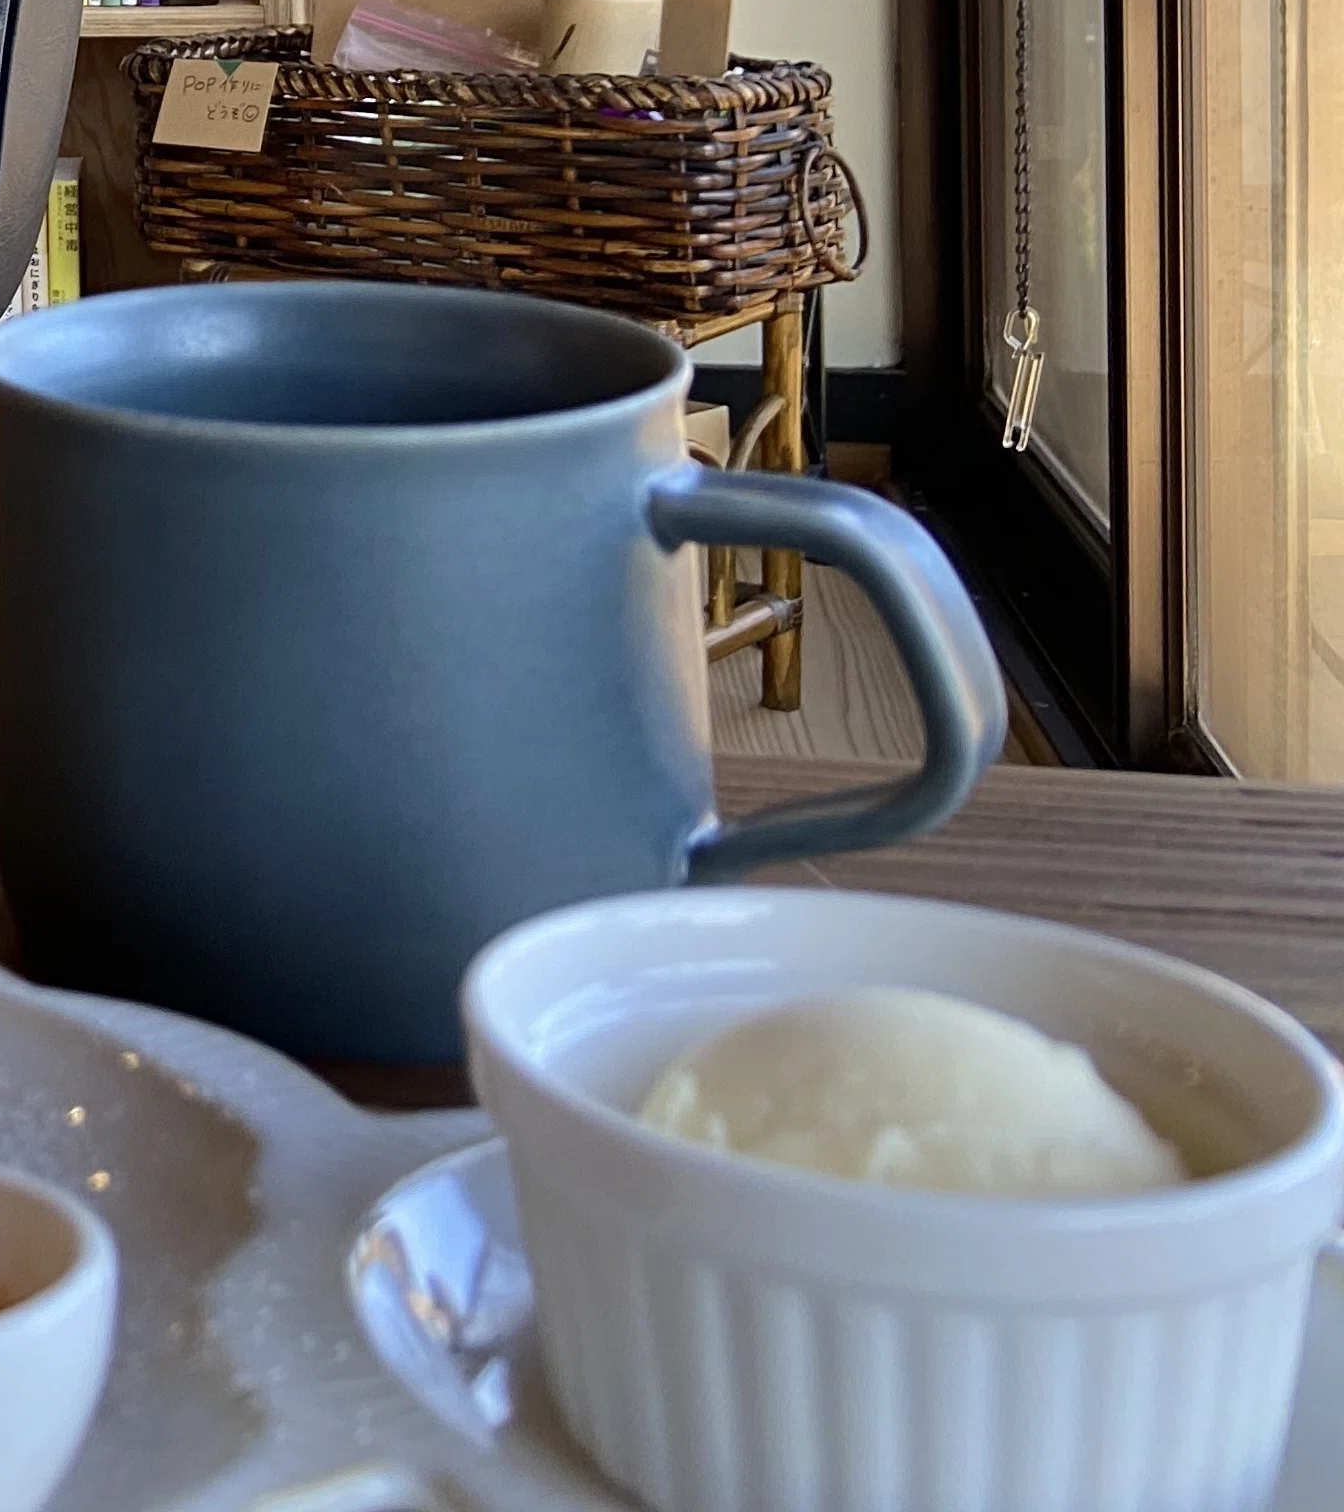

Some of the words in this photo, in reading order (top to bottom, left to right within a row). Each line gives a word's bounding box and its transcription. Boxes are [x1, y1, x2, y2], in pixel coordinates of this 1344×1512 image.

[206, 100, 241, 121] どうぞ
[64, 184, 78, 252] 経営中毒
